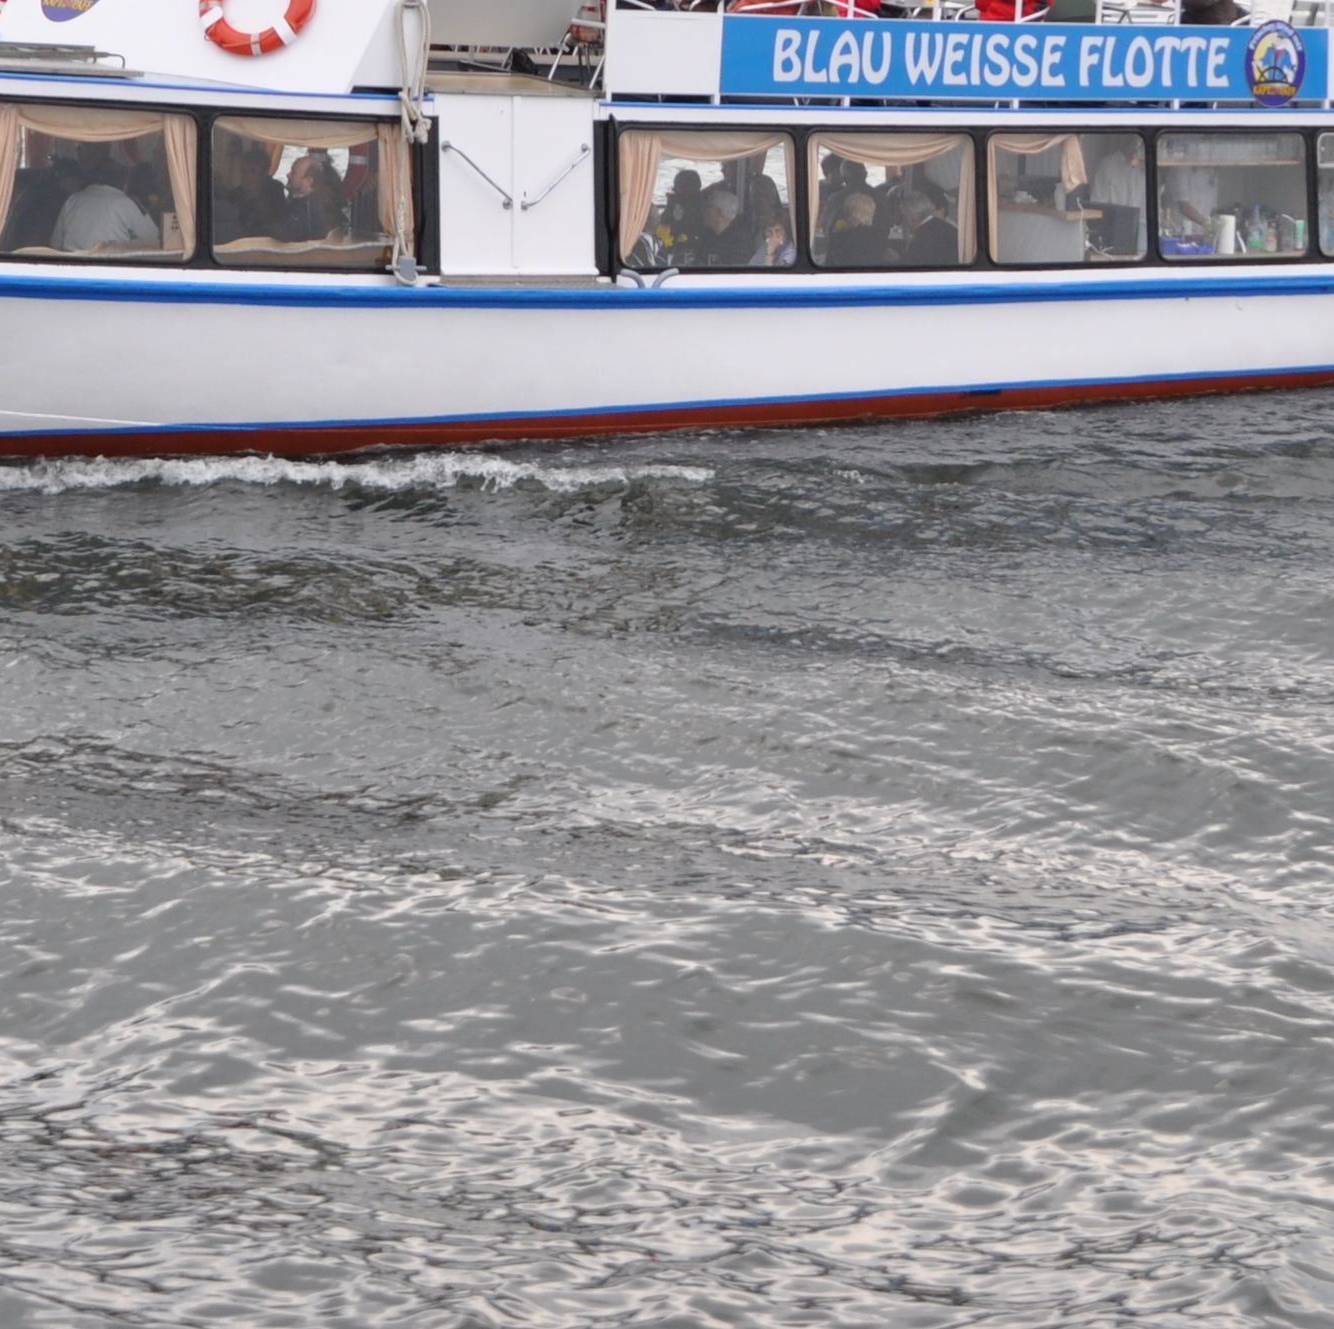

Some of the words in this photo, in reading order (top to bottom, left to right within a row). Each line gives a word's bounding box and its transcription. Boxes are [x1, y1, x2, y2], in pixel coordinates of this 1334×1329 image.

[773, 29, 892, 84] BLAU
[904, 32, 1067, 87] WEISSE
[1079, 35, 1231, 88] FLOTTE
